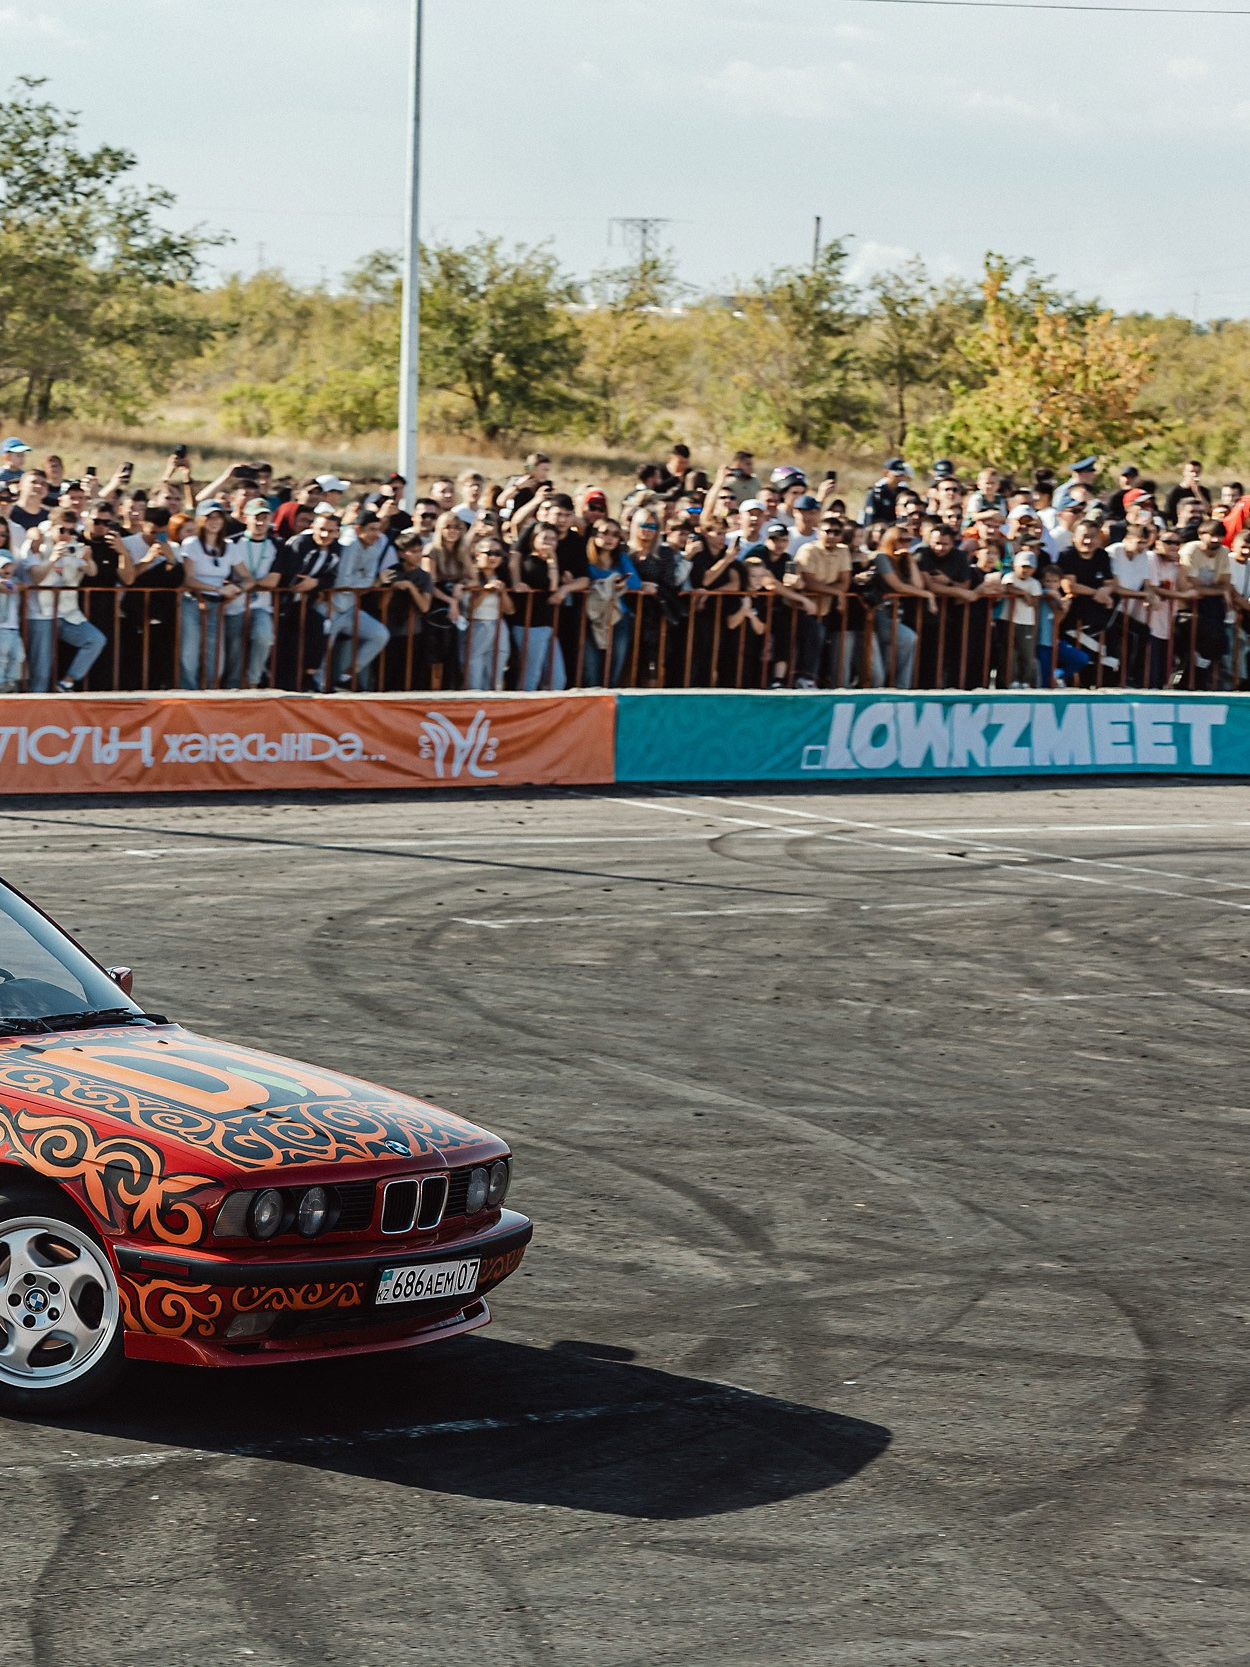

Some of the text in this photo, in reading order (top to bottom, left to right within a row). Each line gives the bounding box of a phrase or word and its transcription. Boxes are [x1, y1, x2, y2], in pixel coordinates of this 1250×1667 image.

[825, 702, 1229, 770] LOWKZMEET
[377, 1289, 390, 1301] KZ
[458, 1262, 479, 1291] 07
